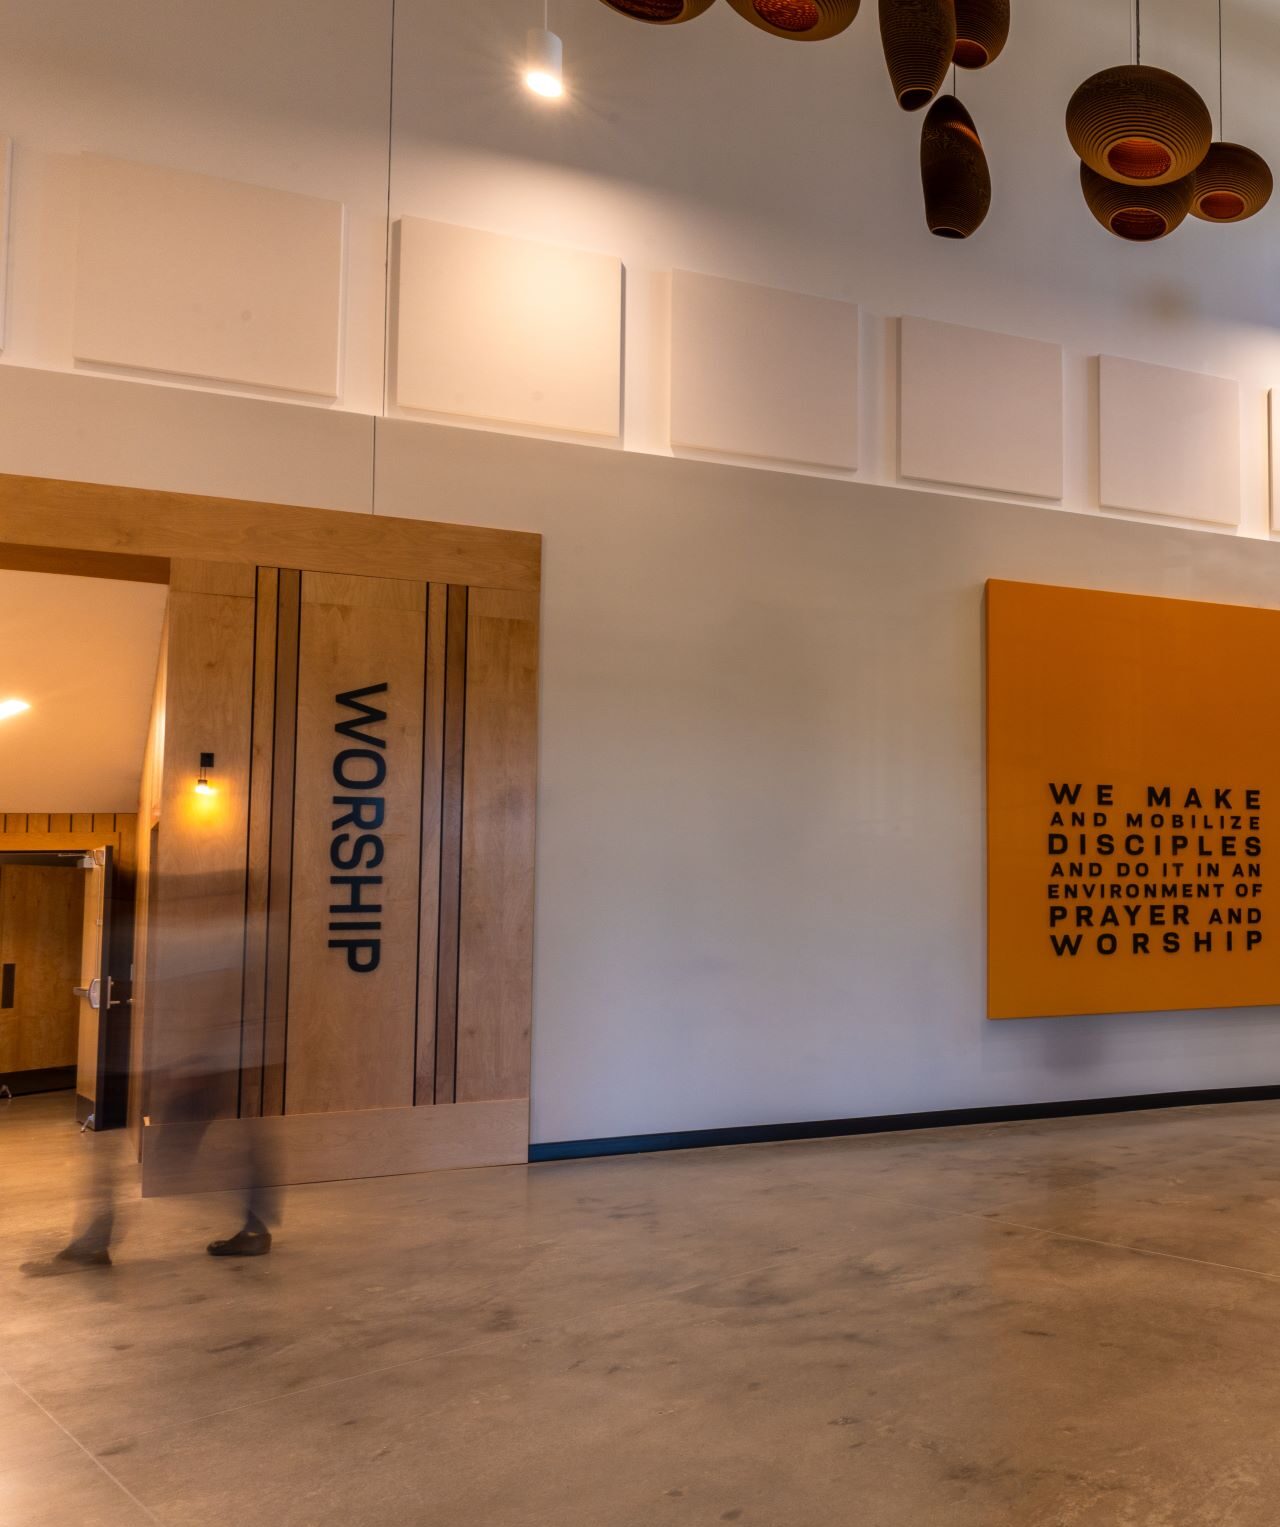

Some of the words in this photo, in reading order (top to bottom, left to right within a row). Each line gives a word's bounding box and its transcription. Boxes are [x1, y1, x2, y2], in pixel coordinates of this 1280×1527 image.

[1048, 782, 1114, 806] WE
[1147, 786, 1261, 810] MAKE
[328, 682, 388, 973] WORSHIP
[1050, 811, 1107, 828] AND
[1126, 813, 1260, 830] MOBILIZE
[1048, 833, 1262, 856] DISCIPLES
[1050, 862, 1103, 877] AND
[1117, 862, 1150, 877] DO
[1162, 862, 1185, 877] IT
[1197, 862, 1220, 878] IN
[1232, 863, 1261, 877] AN
[1048, 883, 1225, 899] ENVIRONMENT
[1235, 883, 1263, 897] OF
[1049, 904, 1190, 928] PRAYER
[1208, 907, 1262, 925] AND
[1049, 930, 1262, 956] WORSHIP
